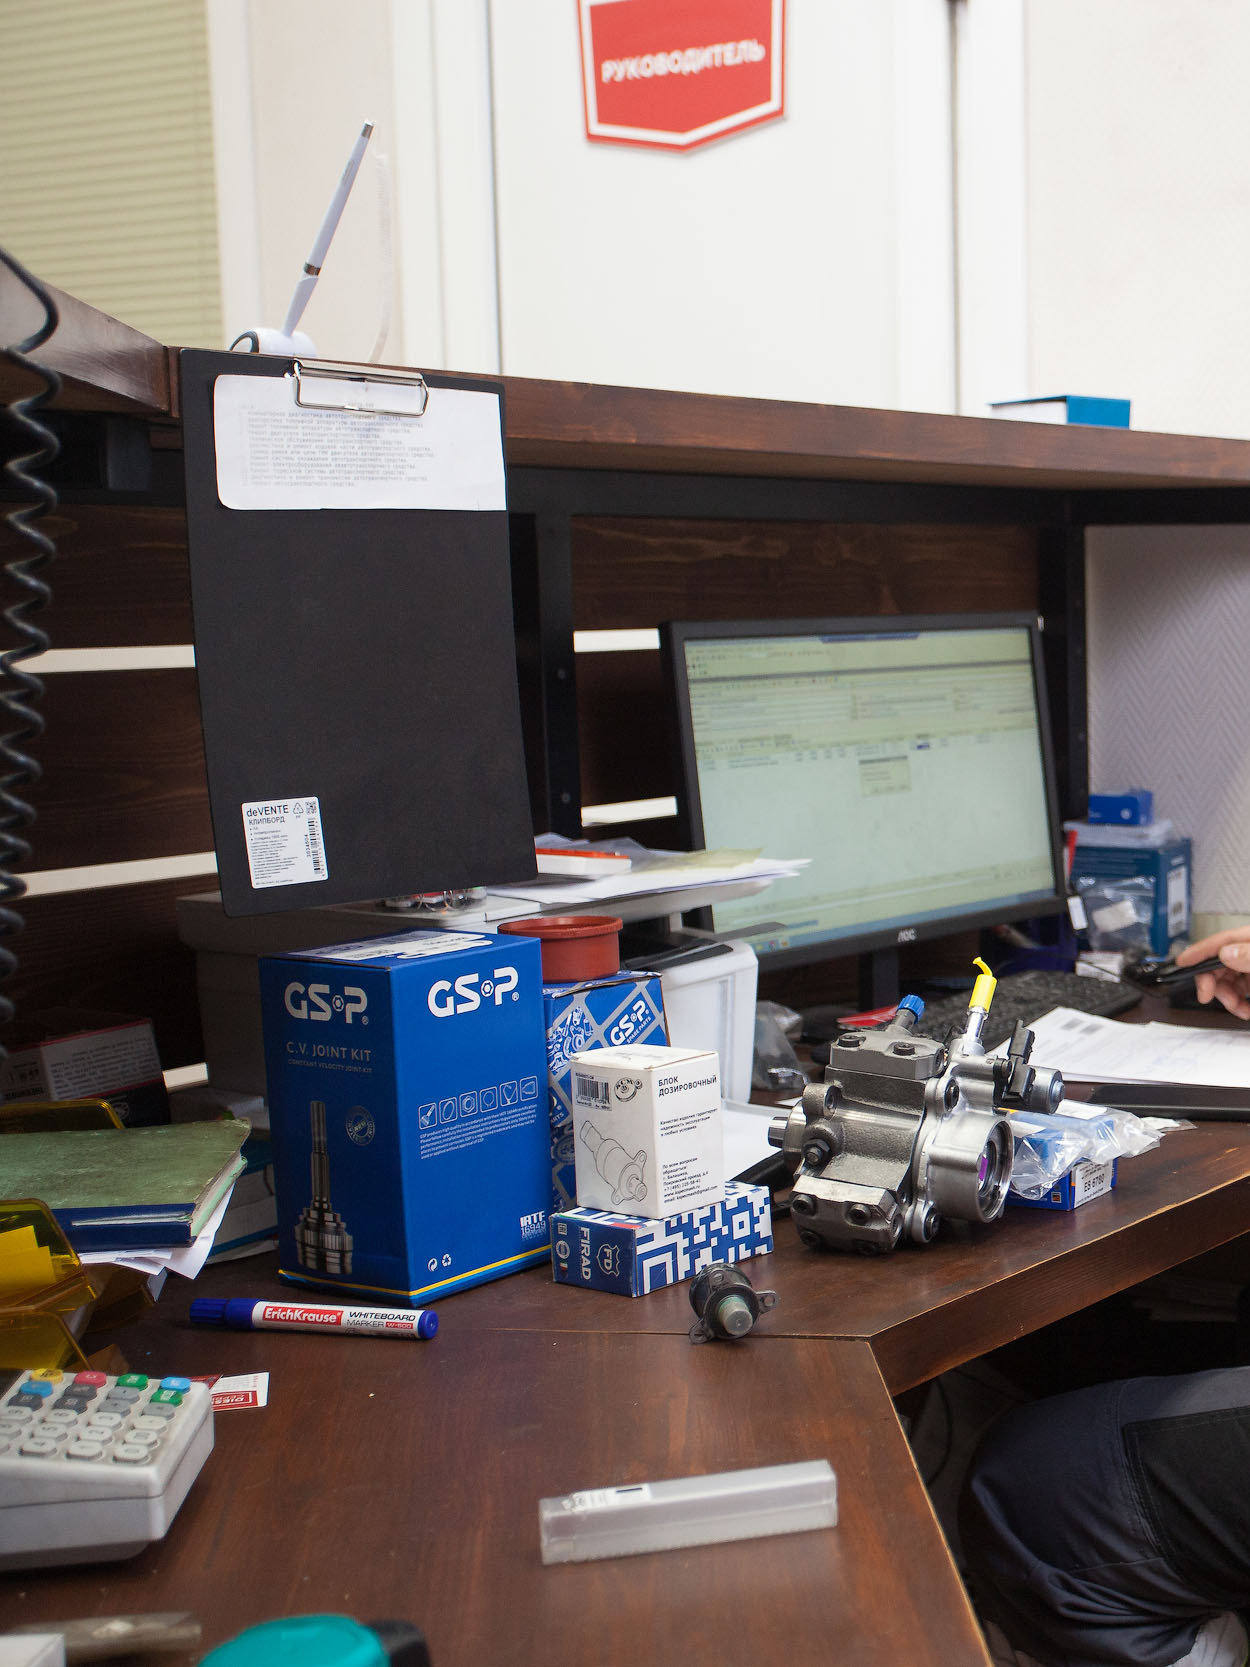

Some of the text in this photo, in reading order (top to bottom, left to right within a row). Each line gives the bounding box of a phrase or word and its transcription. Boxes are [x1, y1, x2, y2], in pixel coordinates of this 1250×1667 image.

[601, 38, 766, 84] РУКОВОДИТЕЛЬ
[246, 804, 289, 817] deVENTE
[249, 816, 286, 825] КЛИПБОРД
[638, 1016, 652, 1031] PARTS
[287, 1041, 372, 1062] C.V. JOINT KIT
[658, 1076, 679, 1087] БЛОК
[658, 1074, 717, 1098] ДОЗИРОВОЧНЫЙ
[679, 1157, 698, 1165] вопросам
[1084, 1180, 1091, 1192] ES
[520, 1211, 545, 1227] IATF
[521, 1220, 546, 1235] 16949
[580, 1226, 591, 1280] FIRAD
[604, 1248, 613, 1271] FD
[264, 1308, 340, 1323] ErichKrause
[349, 1311, 416, 1322] WHITEBOARD
[347, 1319, 385, 1328] MARKER
